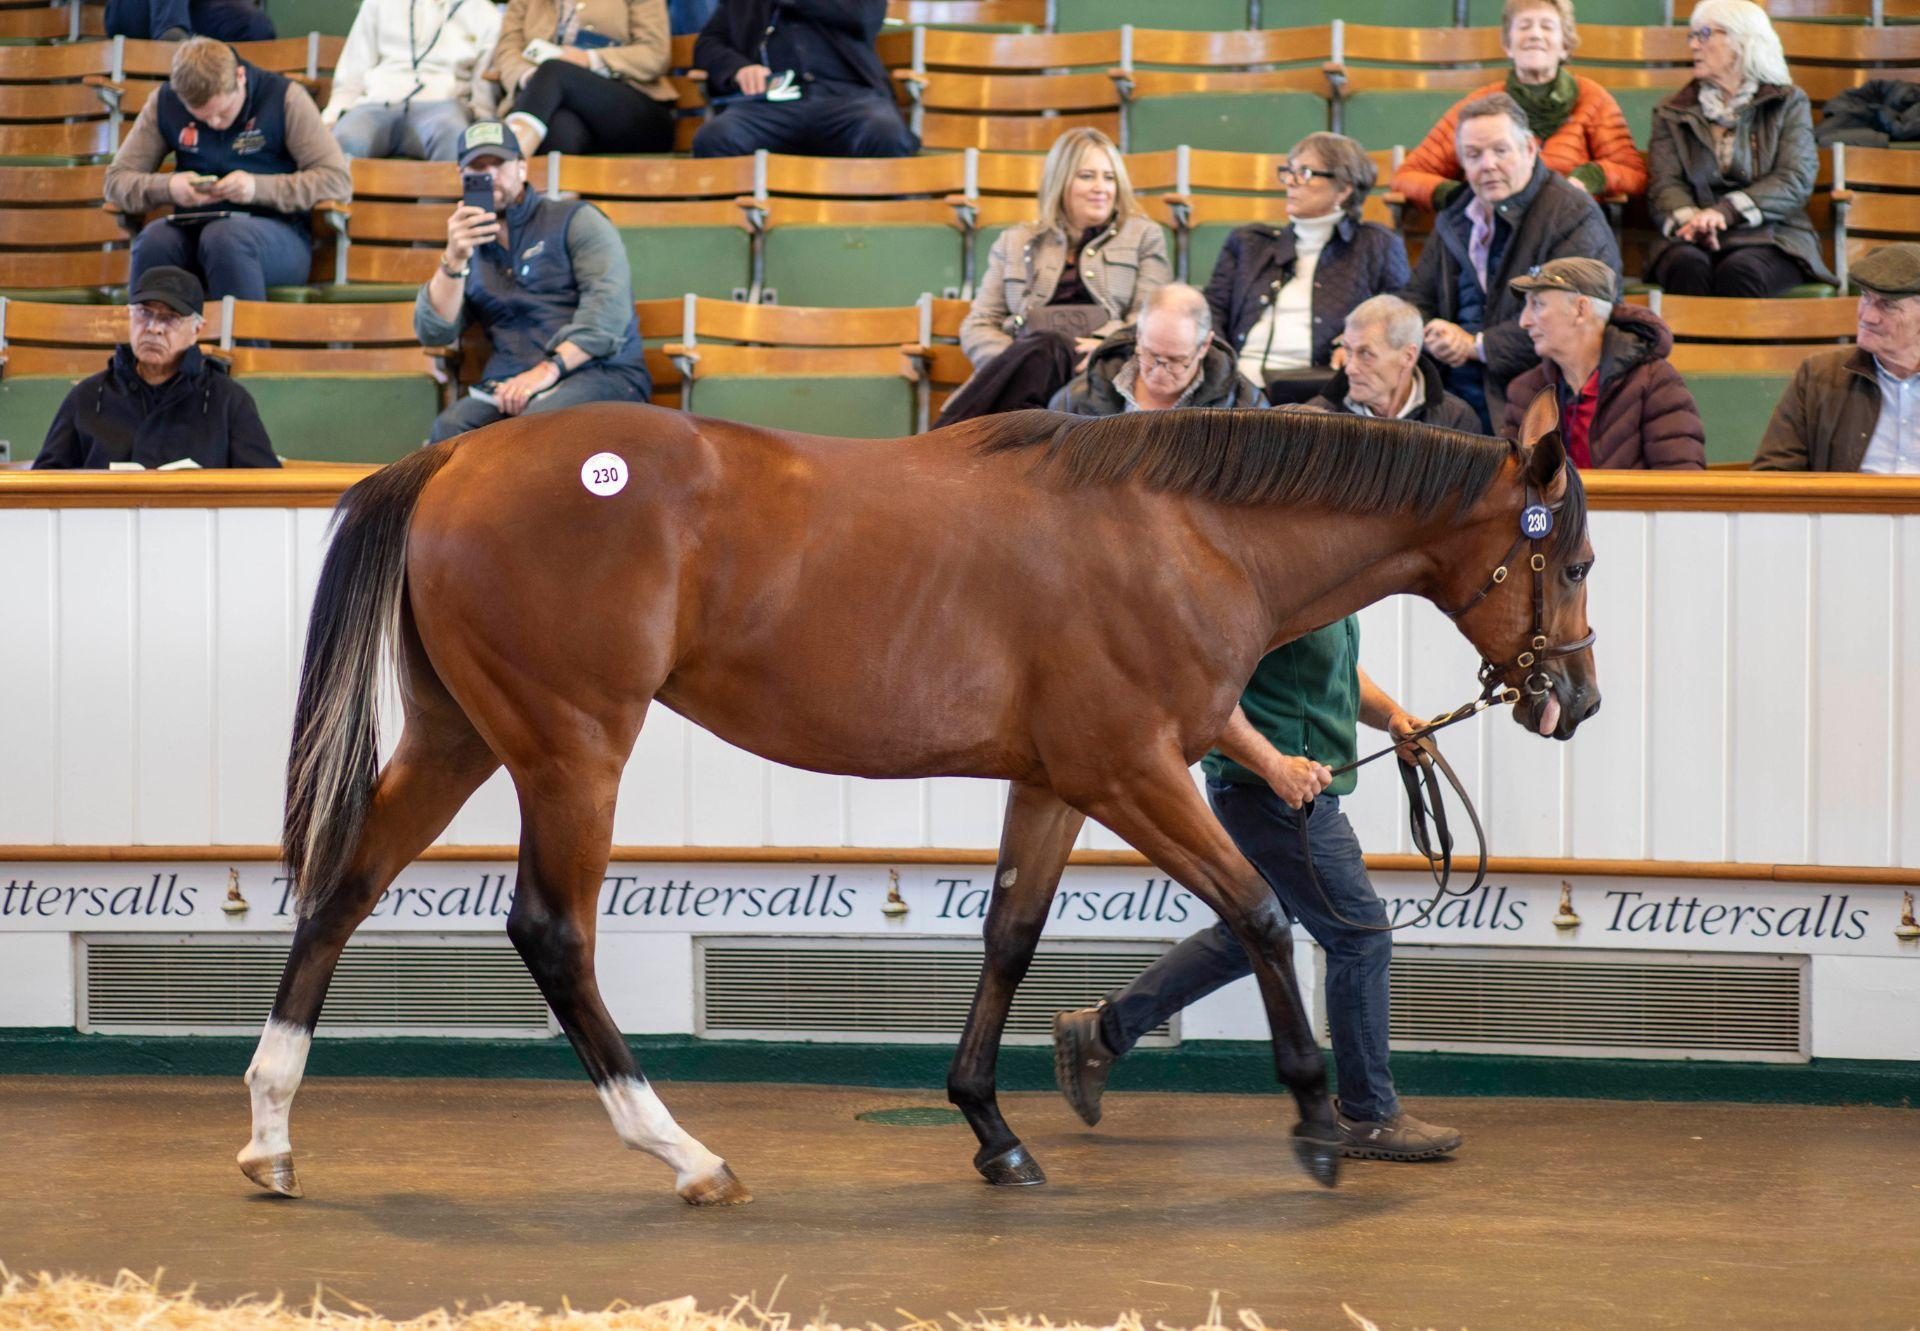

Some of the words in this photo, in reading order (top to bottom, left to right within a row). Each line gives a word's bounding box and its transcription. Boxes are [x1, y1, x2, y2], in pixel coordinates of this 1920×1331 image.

[593, 467, 618, 484] 230
[1528, 513, 1547, 532] 230
[2, 873, 198, 916] ttersalls
[271, 873, 516, 917] Tersall
[602, 874, 856, 917] Tattersalls
[935, 879, 1191, 922] Tarsalls
[1379, 886, 1527, 930] rsalls
[1605, 891, 1869, 939] Tattersalls
